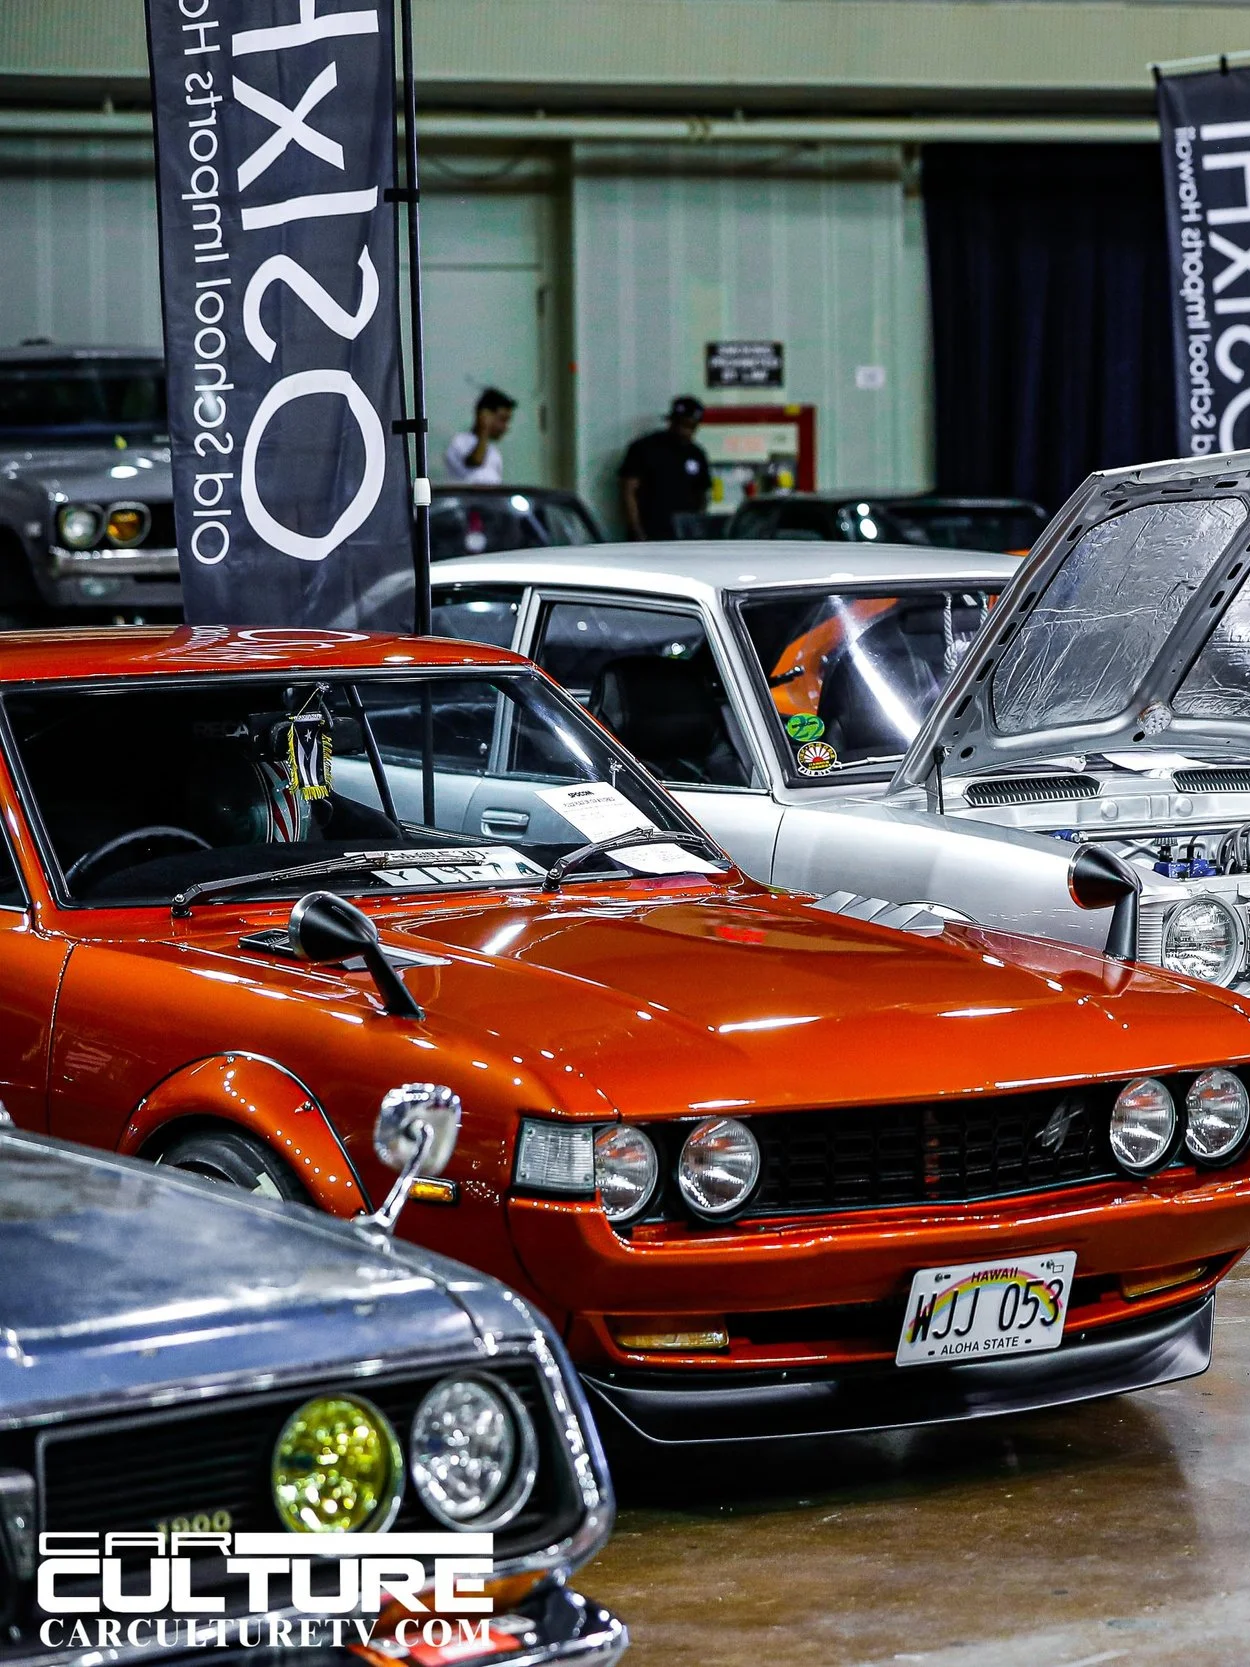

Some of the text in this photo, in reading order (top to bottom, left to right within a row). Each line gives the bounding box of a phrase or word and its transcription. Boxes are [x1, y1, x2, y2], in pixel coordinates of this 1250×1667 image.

[971, 1267, 1018, 1283] HAWAII
[910, 1278, 1064, 1343] WJJ 053
[941, 1336, 1019, 1356] ALOHA STATE
